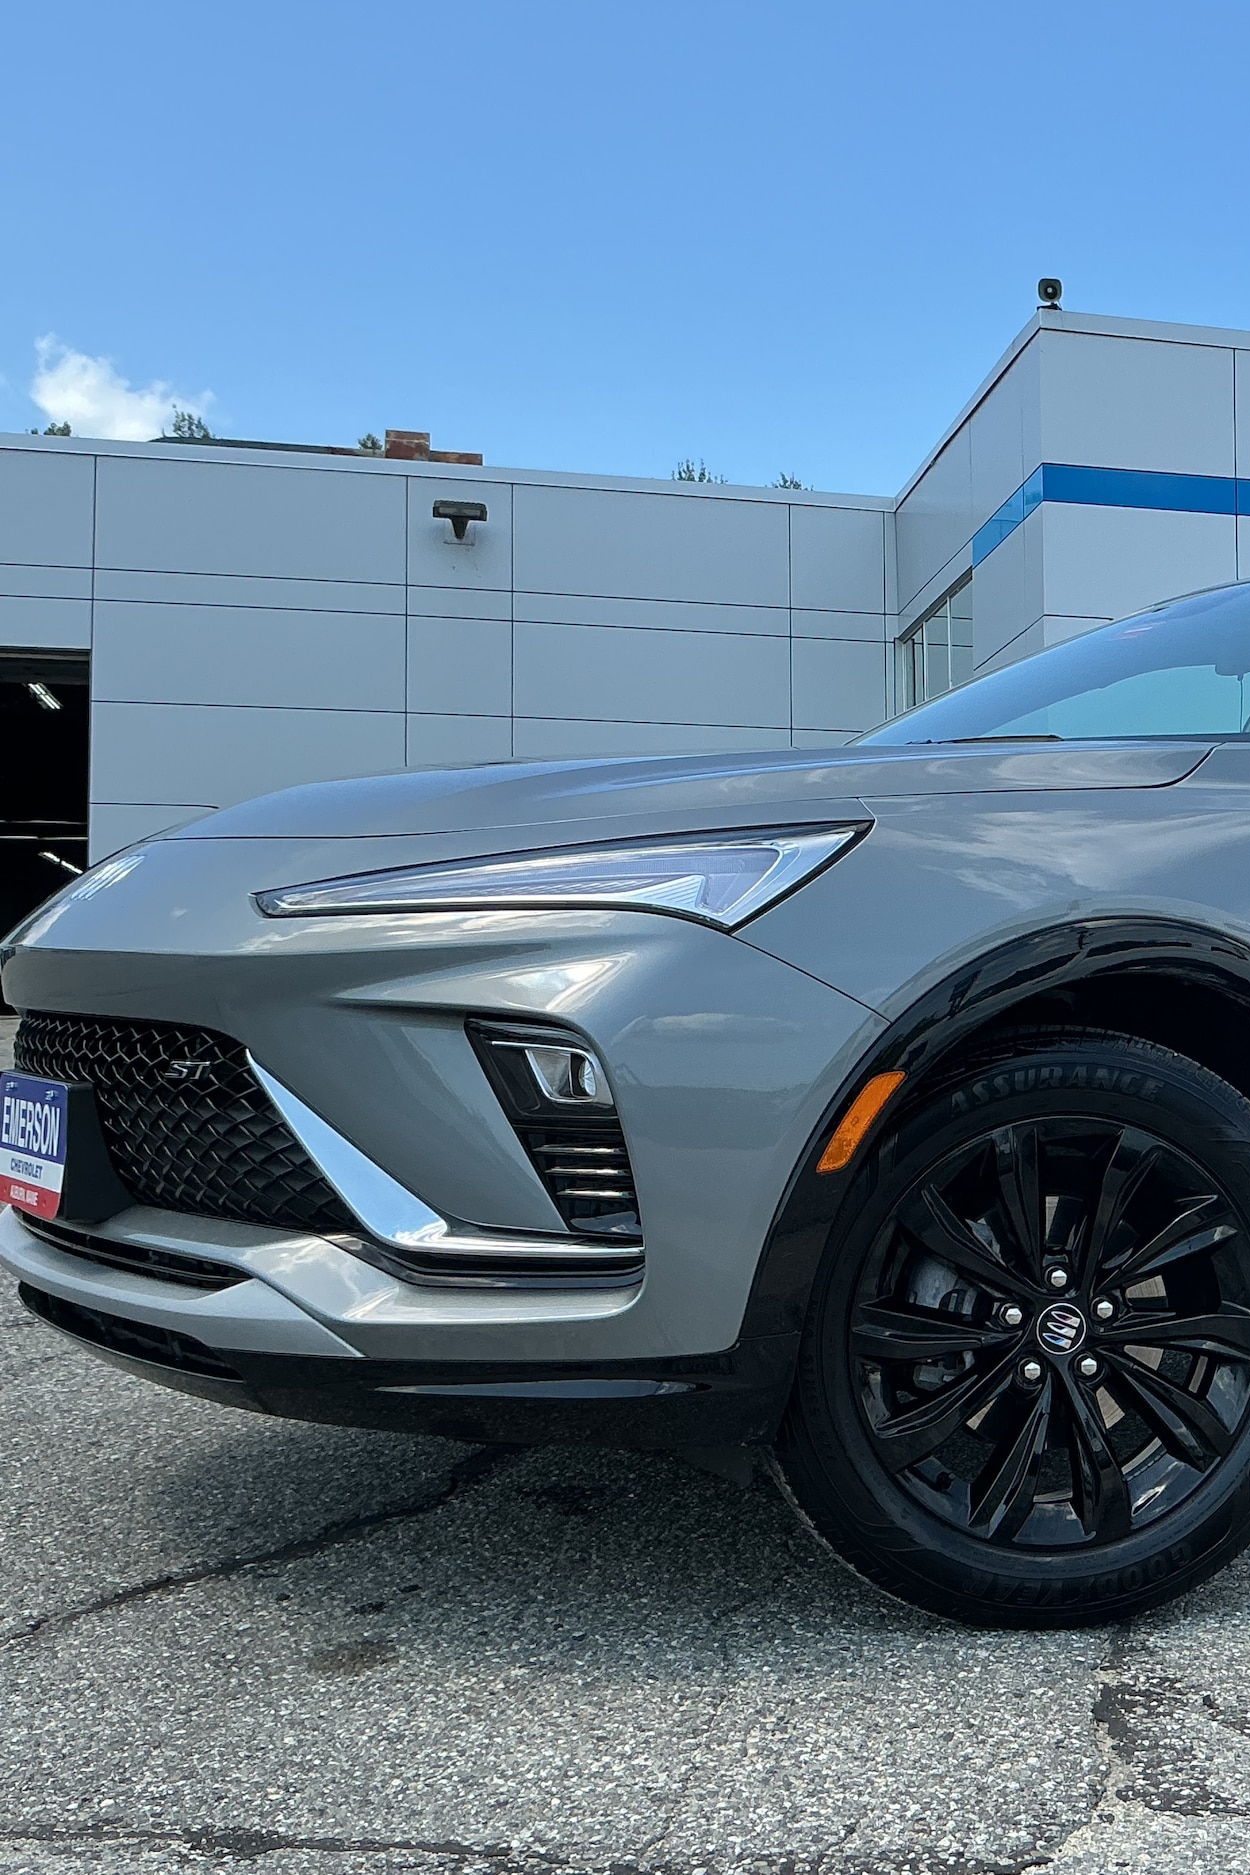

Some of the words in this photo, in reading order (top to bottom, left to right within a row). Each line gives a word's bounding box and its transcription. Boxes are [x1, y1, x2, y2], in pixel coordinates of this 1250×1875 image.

[164, 1060, 211, 1080] ST
[951, 1065, 1166, 1115] ASSURANCE
[2, 1096, 61, 1157] EMERSON
[10, 1158, 43, 1180] CHEVROLET
[962, 1541, 1195, 1606] GOODYEAR
